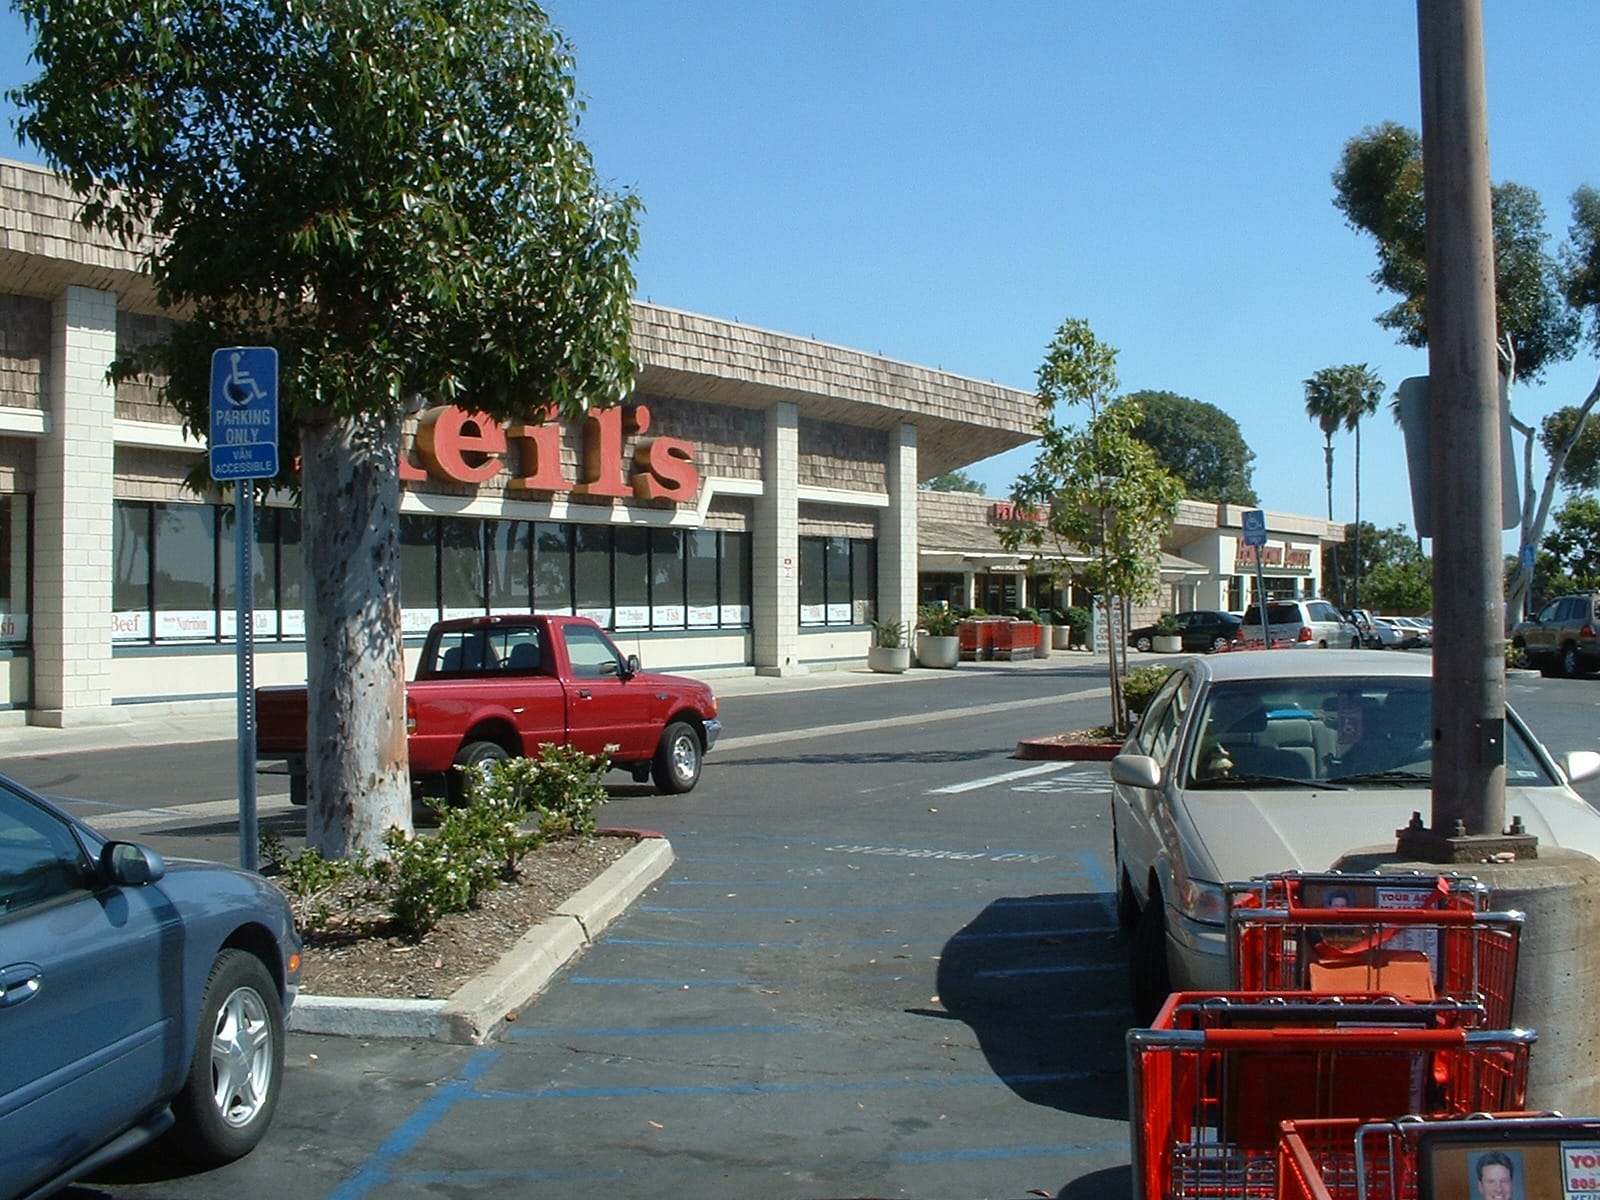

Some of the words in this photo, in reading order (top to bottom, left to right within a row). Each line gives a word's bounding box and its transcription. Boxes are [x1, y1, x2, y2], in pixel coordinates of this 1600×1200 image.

[215, 409, 271, 426] PARKING
[225, 428, 259, 444] ONLY
[233, 447, 253, 460] VAN
[295, 401, 699, 501] eil's
[215, 460, 273, 474] ACCESSIBLE
[112, 614, 141, 632] Beef
[1381, 893, 1409, 901] YOUR
[1570, 1154, 1600, 1169] YO
